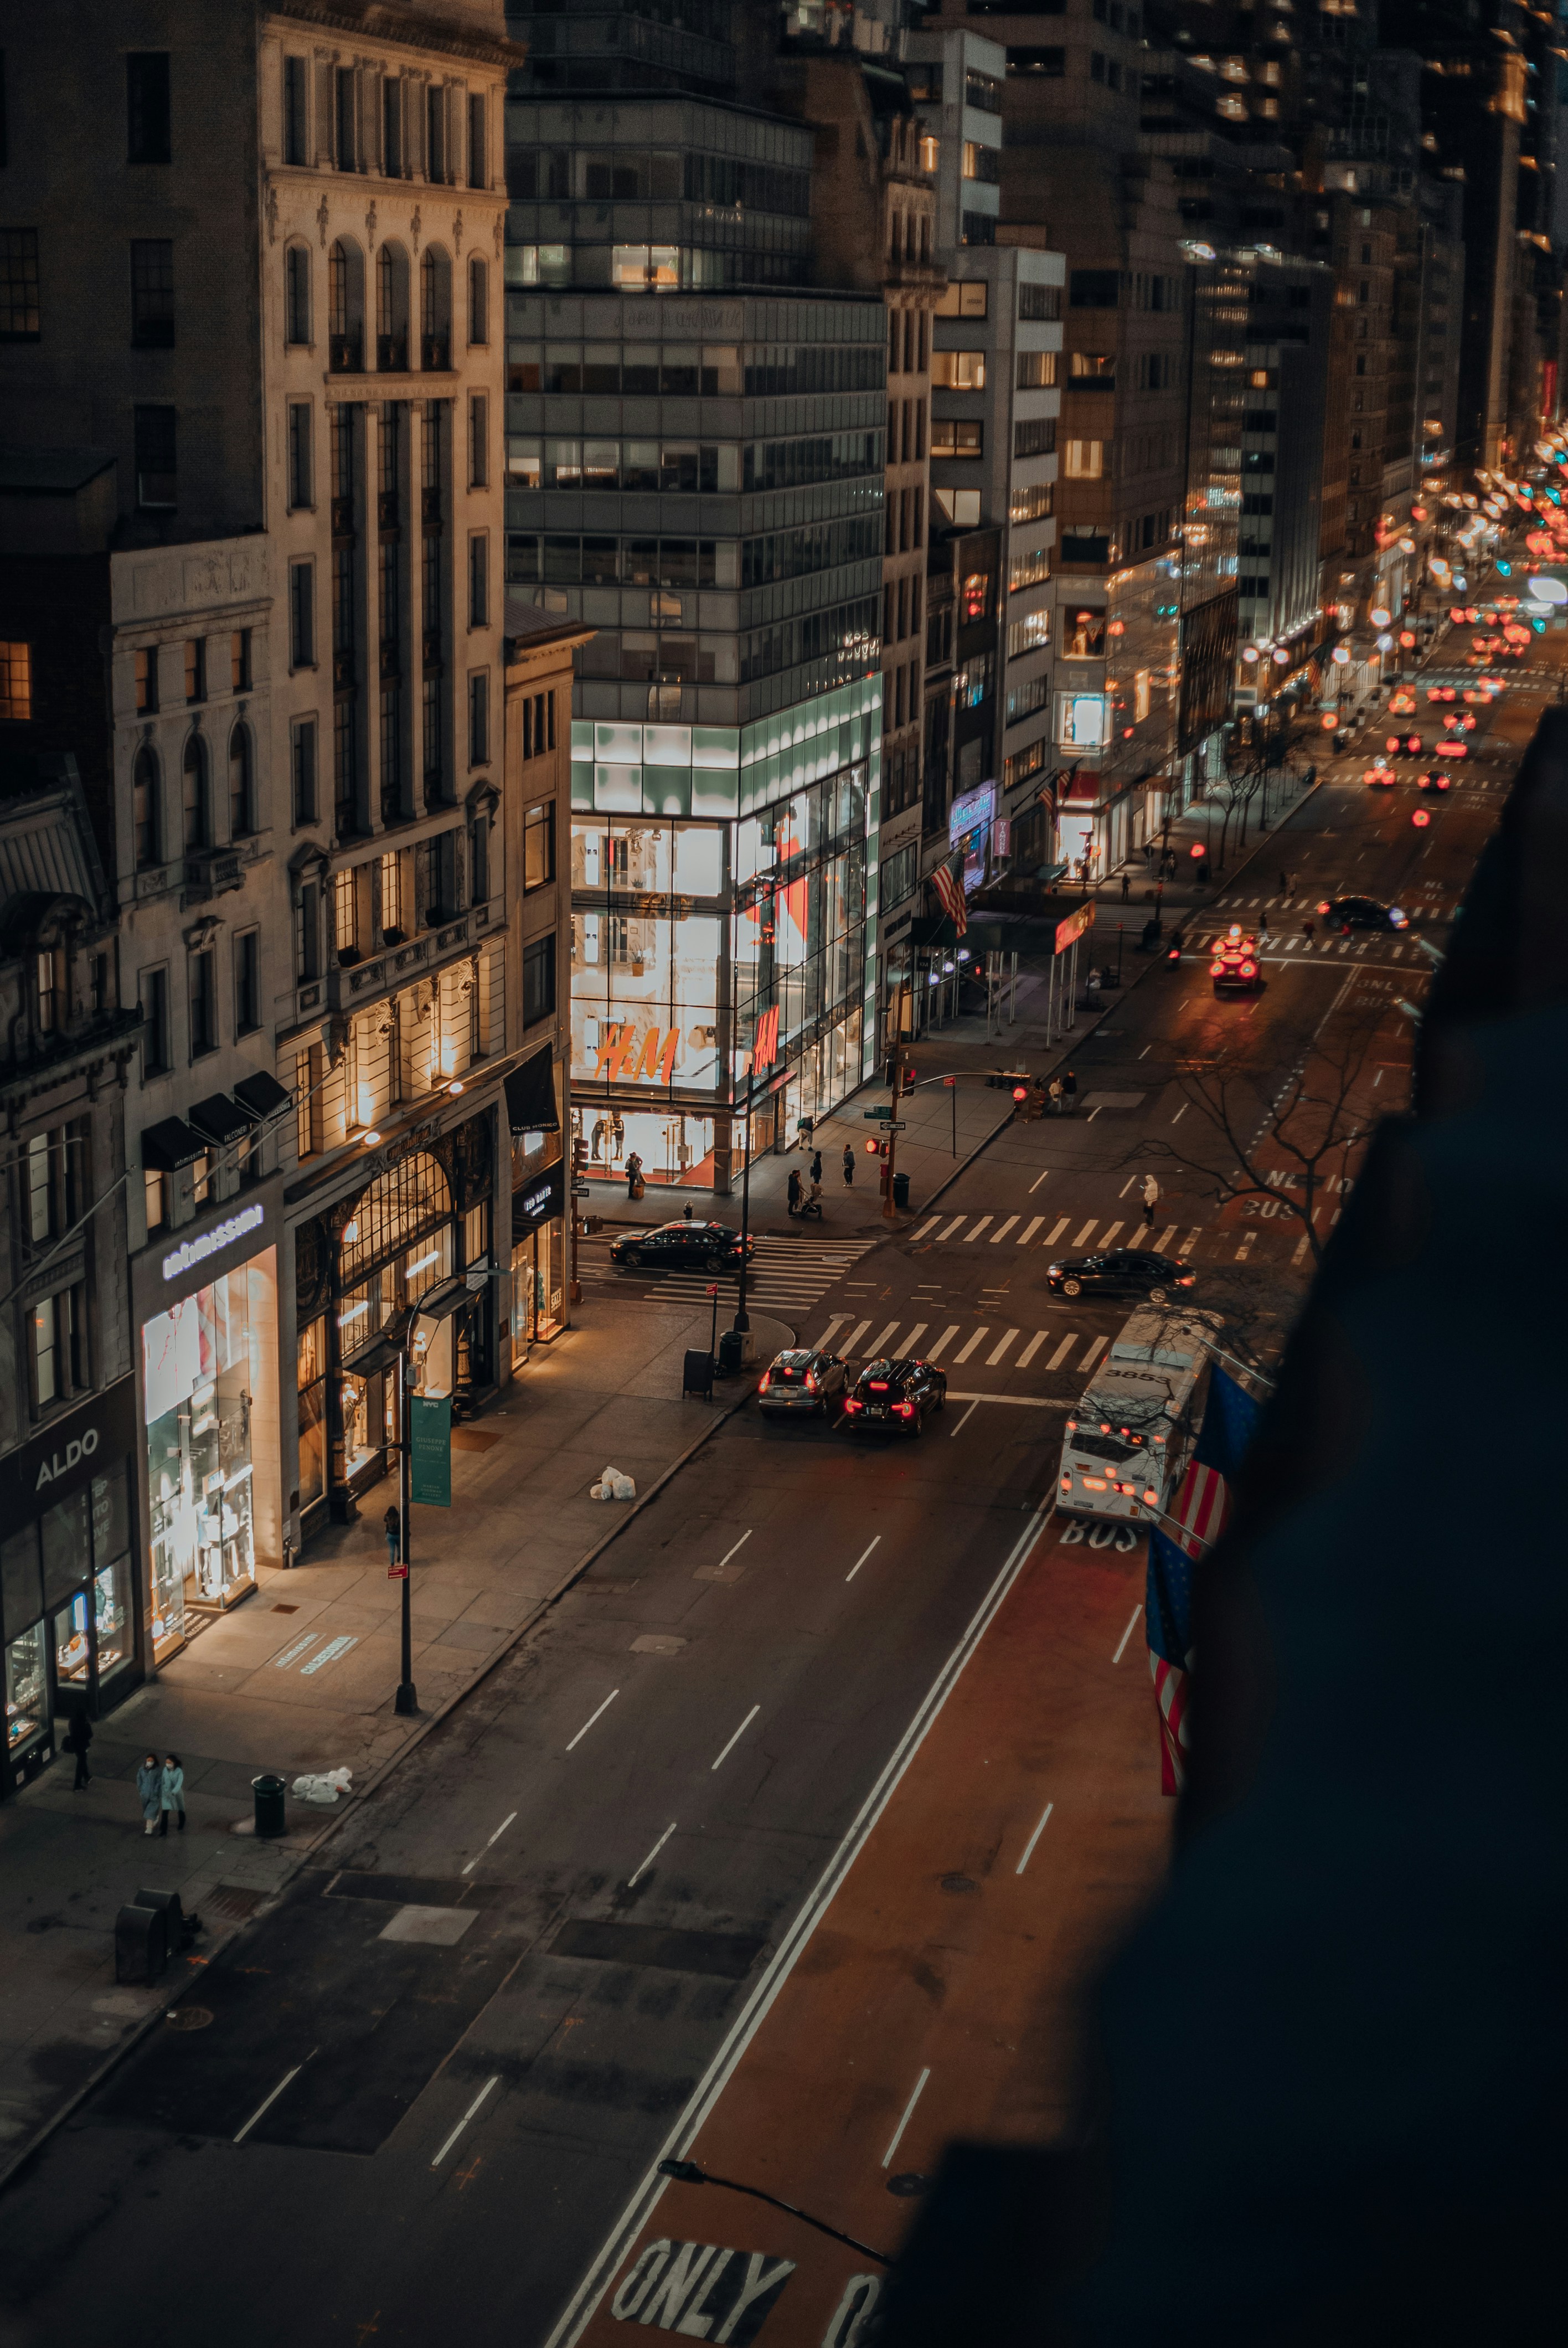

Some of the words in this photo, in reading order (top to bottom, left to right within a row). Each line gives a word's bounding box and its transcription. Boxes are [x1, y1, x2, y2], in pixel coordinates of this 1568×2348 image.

[1137, 783, 1170, 794] GUESS
[595, 1024, 680, 1087] H&M
[224, 1125, 247, 1143] FALCONERI
[551, 1292, 561, 1309] SALE
[1105, 1369, 1172, 1384] 3853
[416, 1436, 446, 1445] GIUSEPPE
[35, 1428, 98, 1491] ALDO
[1059, 1520, 1137, 1552] BUS
[275, 1633, 318, 1667] intimissimi
[300, 1636, 352, 1674] CALZEDONIA
[611, 2238, 797, 2344] ONLY
